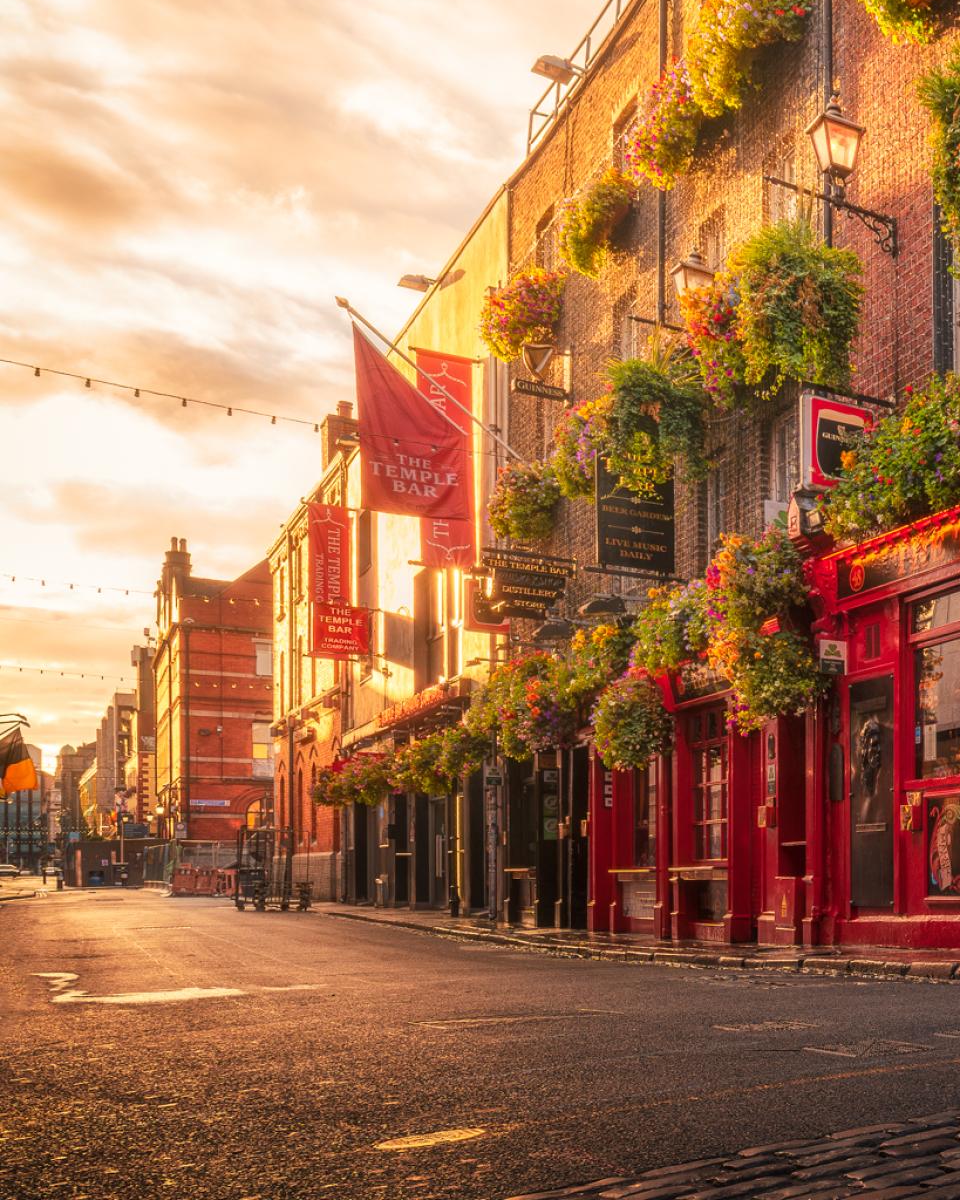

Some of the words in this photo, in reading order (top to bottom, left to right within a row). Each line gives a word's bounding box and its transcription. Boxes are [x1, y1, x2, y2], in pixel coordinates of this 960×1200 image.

[516, 381, 565, 397] GUINNESS
[396, 453, 432, 469] THE
[368, 460, 460, 487] TEMPLE
[392, 479, 439, 498] BAR
[327, 528, 341, 554] THE
[635, 542, 668, 553] MUSIC
[620, 550, 653, 561] DAILY
[314, 553, 324, 593] TRADING
[487, 559, 508, 568] THE
[511, 562, 548, 573] TEMPLE
[550, 567, 569, 576] BAR
[327, 558, 341, 604] TEMPL
[502, 585, 558, 598] DISTILLERY
[330, 607, 351, 616] THE
[319, 614, 364, 627] TEMPLE
[327, 625, 353, 635] BAR
[321, 642, 360, 651] COMPANY
[323, 637, 358, 646] TRADING
